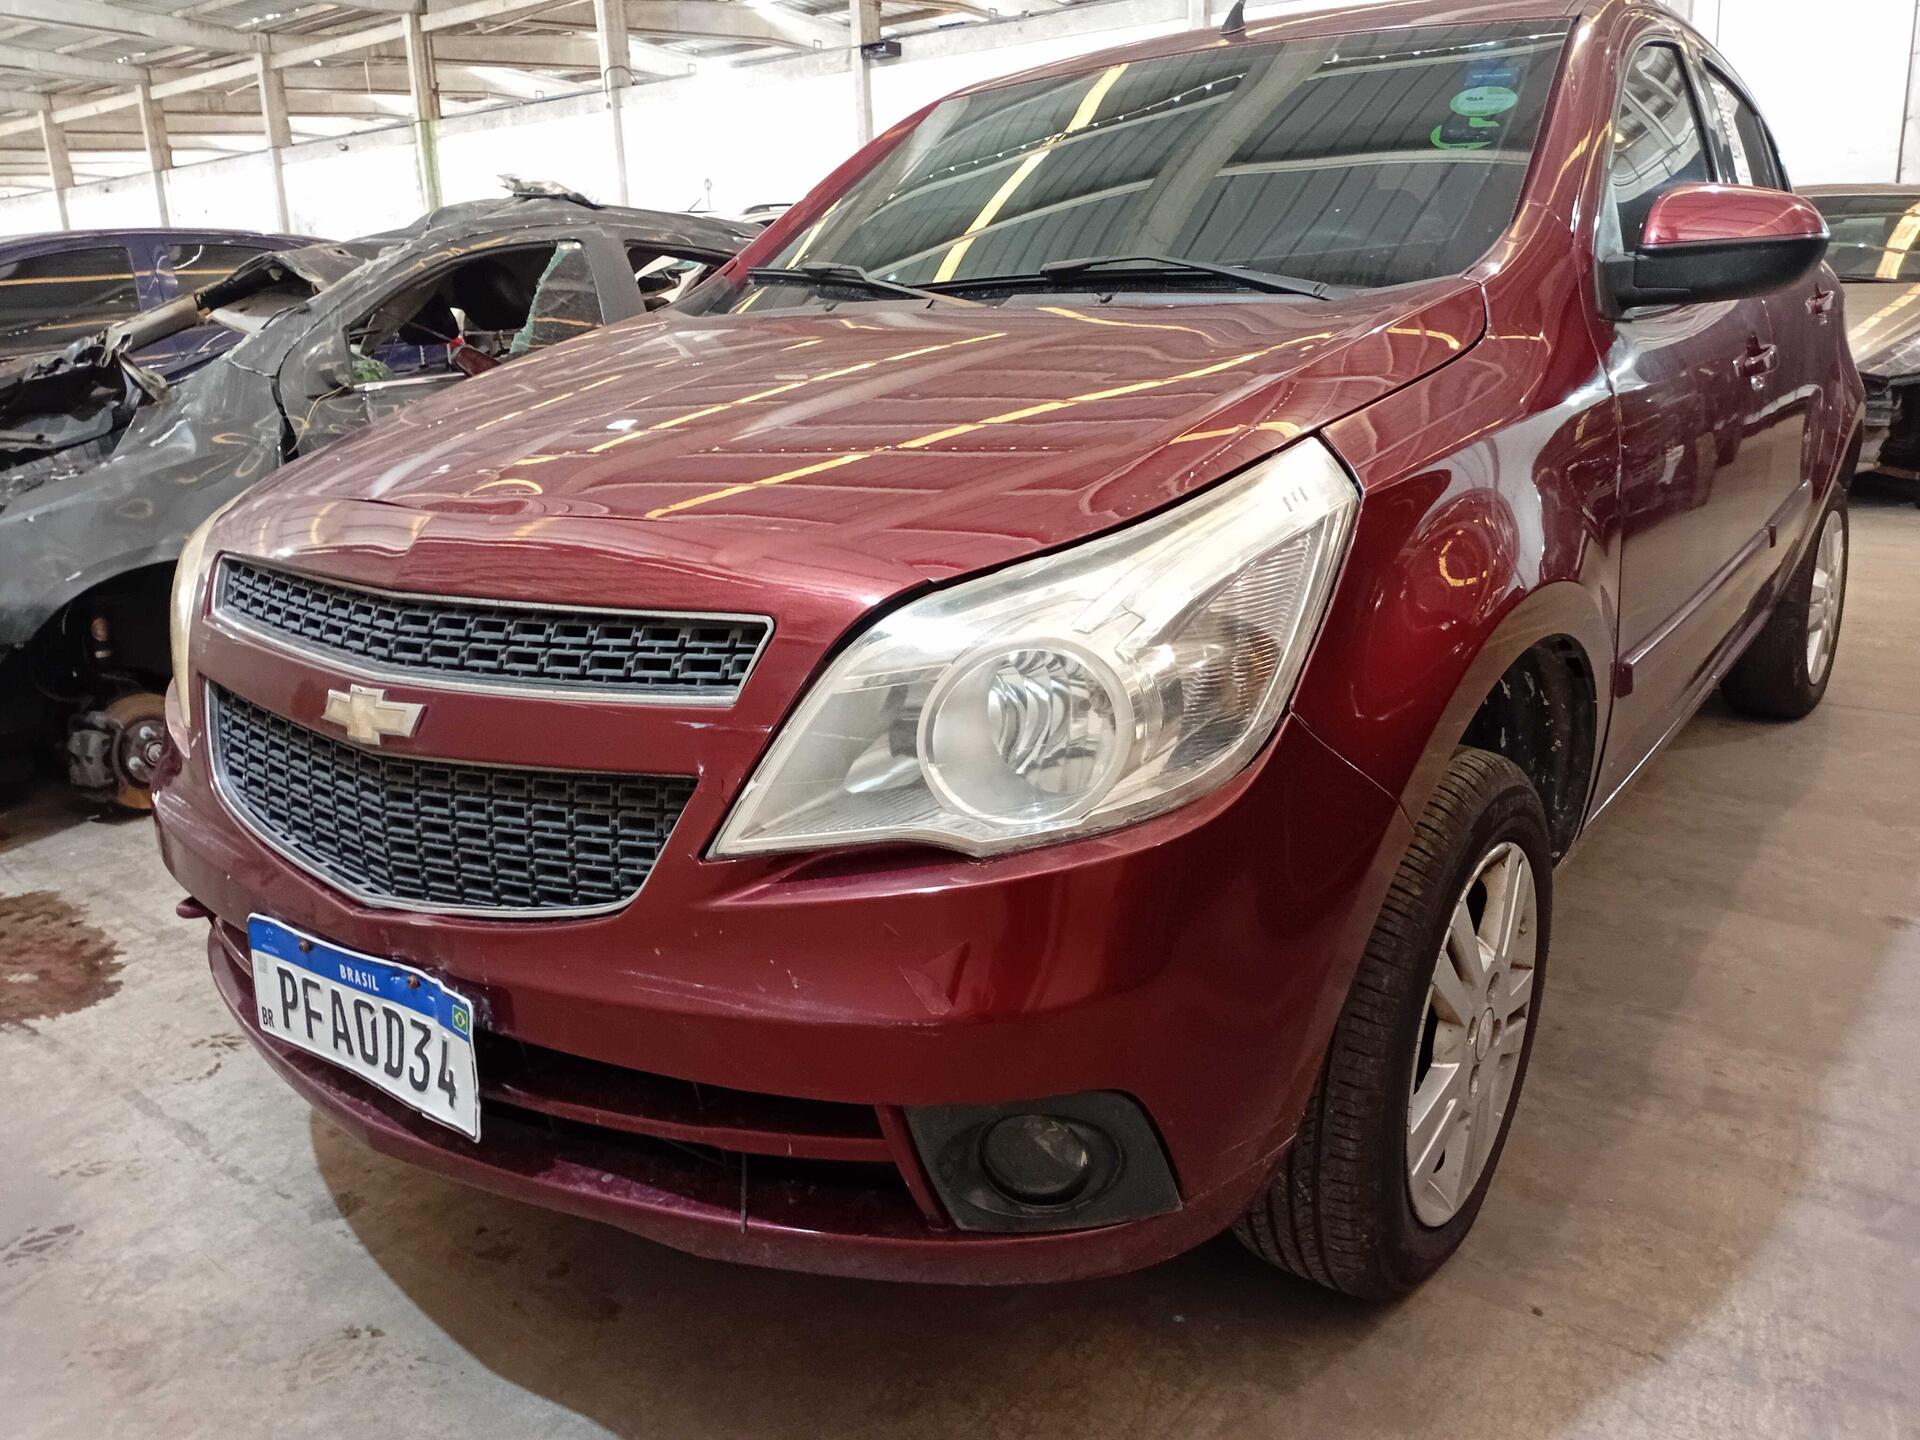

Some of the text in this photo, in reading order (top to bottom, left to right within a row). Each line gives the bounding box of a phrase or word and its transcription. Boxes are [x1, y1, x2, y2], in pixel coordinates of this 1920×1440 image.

[340, 964, 379, 991] BRASIL
[262, 1007, 275, 1028] BR
[277, 966, 457, 1108] PFA0D34
